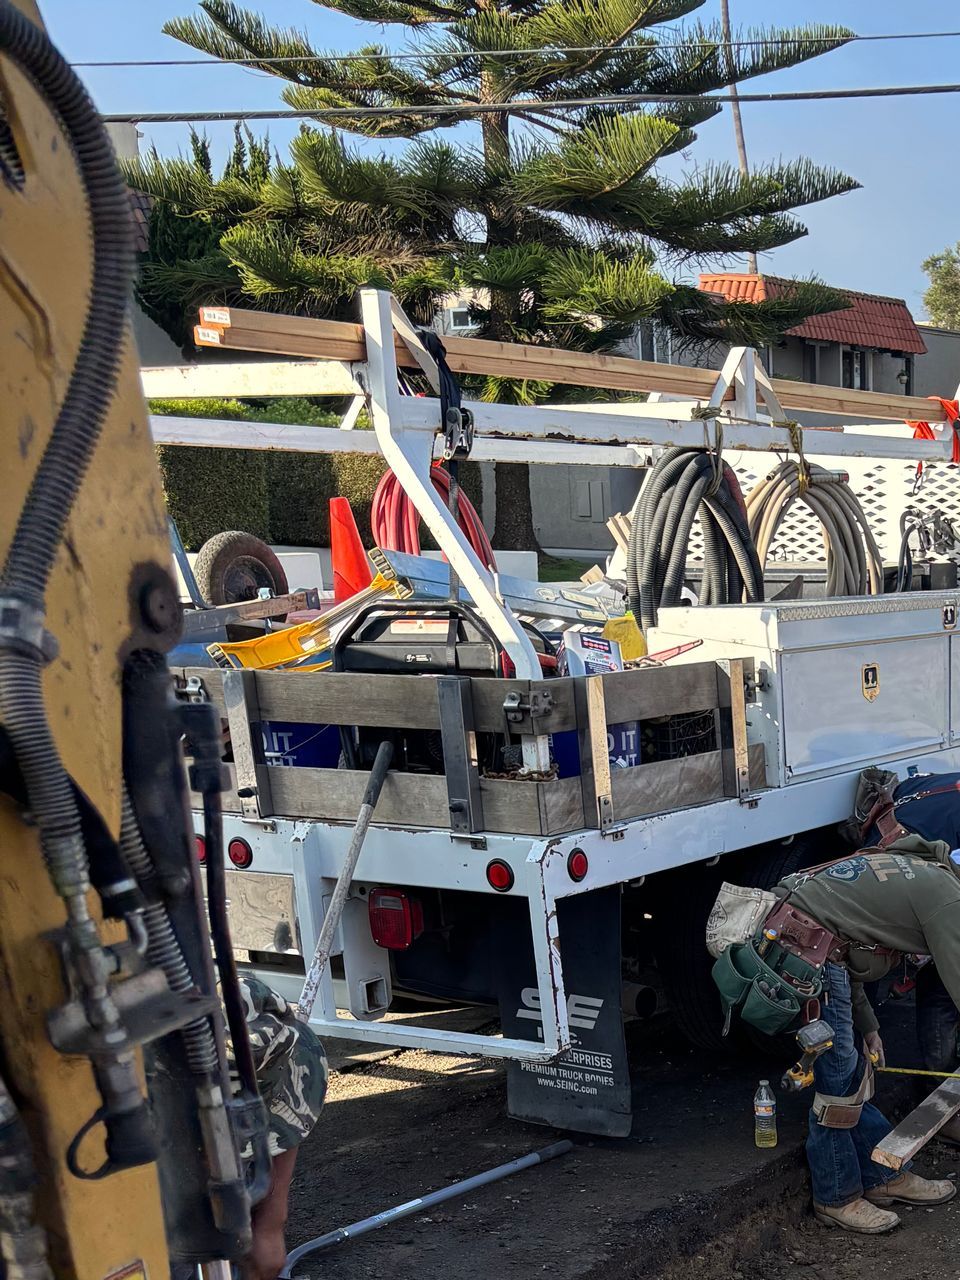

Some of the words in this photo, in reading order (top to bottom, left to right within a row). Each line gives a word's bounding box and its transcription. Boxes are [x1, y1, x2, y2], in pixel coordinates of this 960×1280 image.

[520, 1062, 557, 1076] PREMIUM
[558, 1068, 584, 1081] TRUCK
[584, 1073, 615, 1087] BODIES
[537, 1077, 598, 1095] www.SEINC.com
